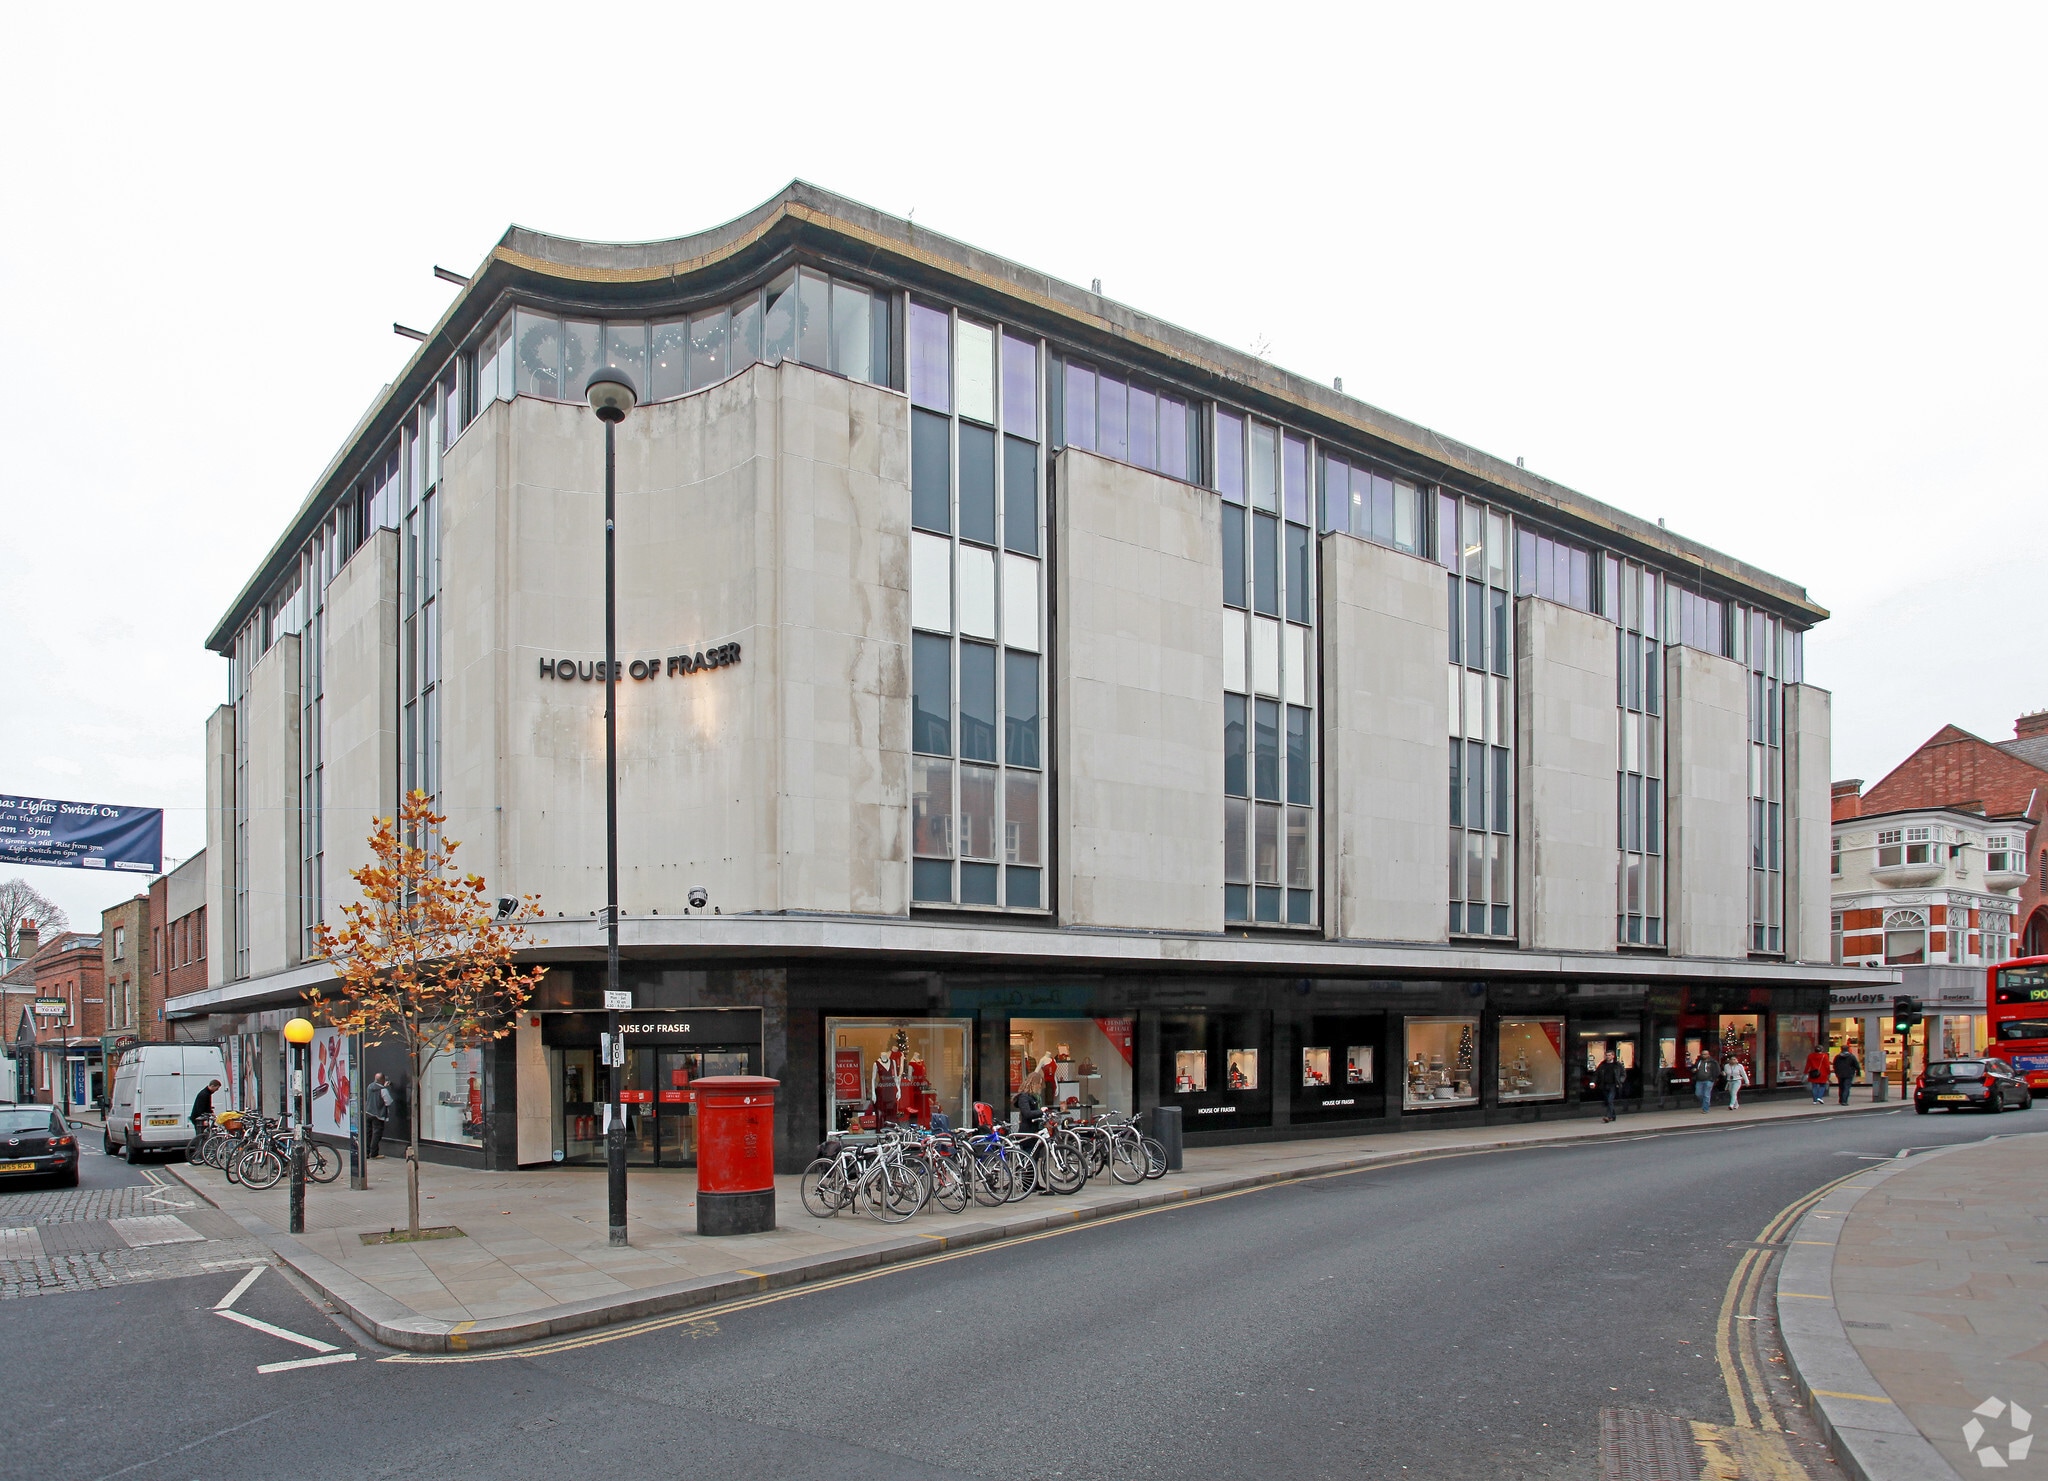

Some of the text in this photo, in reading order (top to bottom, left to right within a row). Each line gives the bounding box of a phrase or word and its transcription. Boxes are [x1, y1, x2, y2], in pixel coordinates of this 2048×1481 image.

[629, 658, 661, 681] OF
[667, 641, 741, 678] FRASER
[18, 799, 57, 815] Lights
[60, 803, 98, 816] Switch
[101, 807, 119, 818] On
[19, 814, 33, 823] the
[34, 815, 53, 825] Hill
[28, 826, 51, 839] 8pm
[38, 839, 52, 847] Hill
[56, 840, 70, 848] Rise
[71, 842, 88, 851] from
[8, 845, 27, 854] Light
[29, 846, 52, 855] Switch
[63, 849, 78, 858] 6pm
[1830, 993, 1885, 1004] Bowleys
[2030, 989, 2048, 1001] 190
[642, 1024, 655, 1033] OF
[657, 1024, 690, 1033] FRASER
